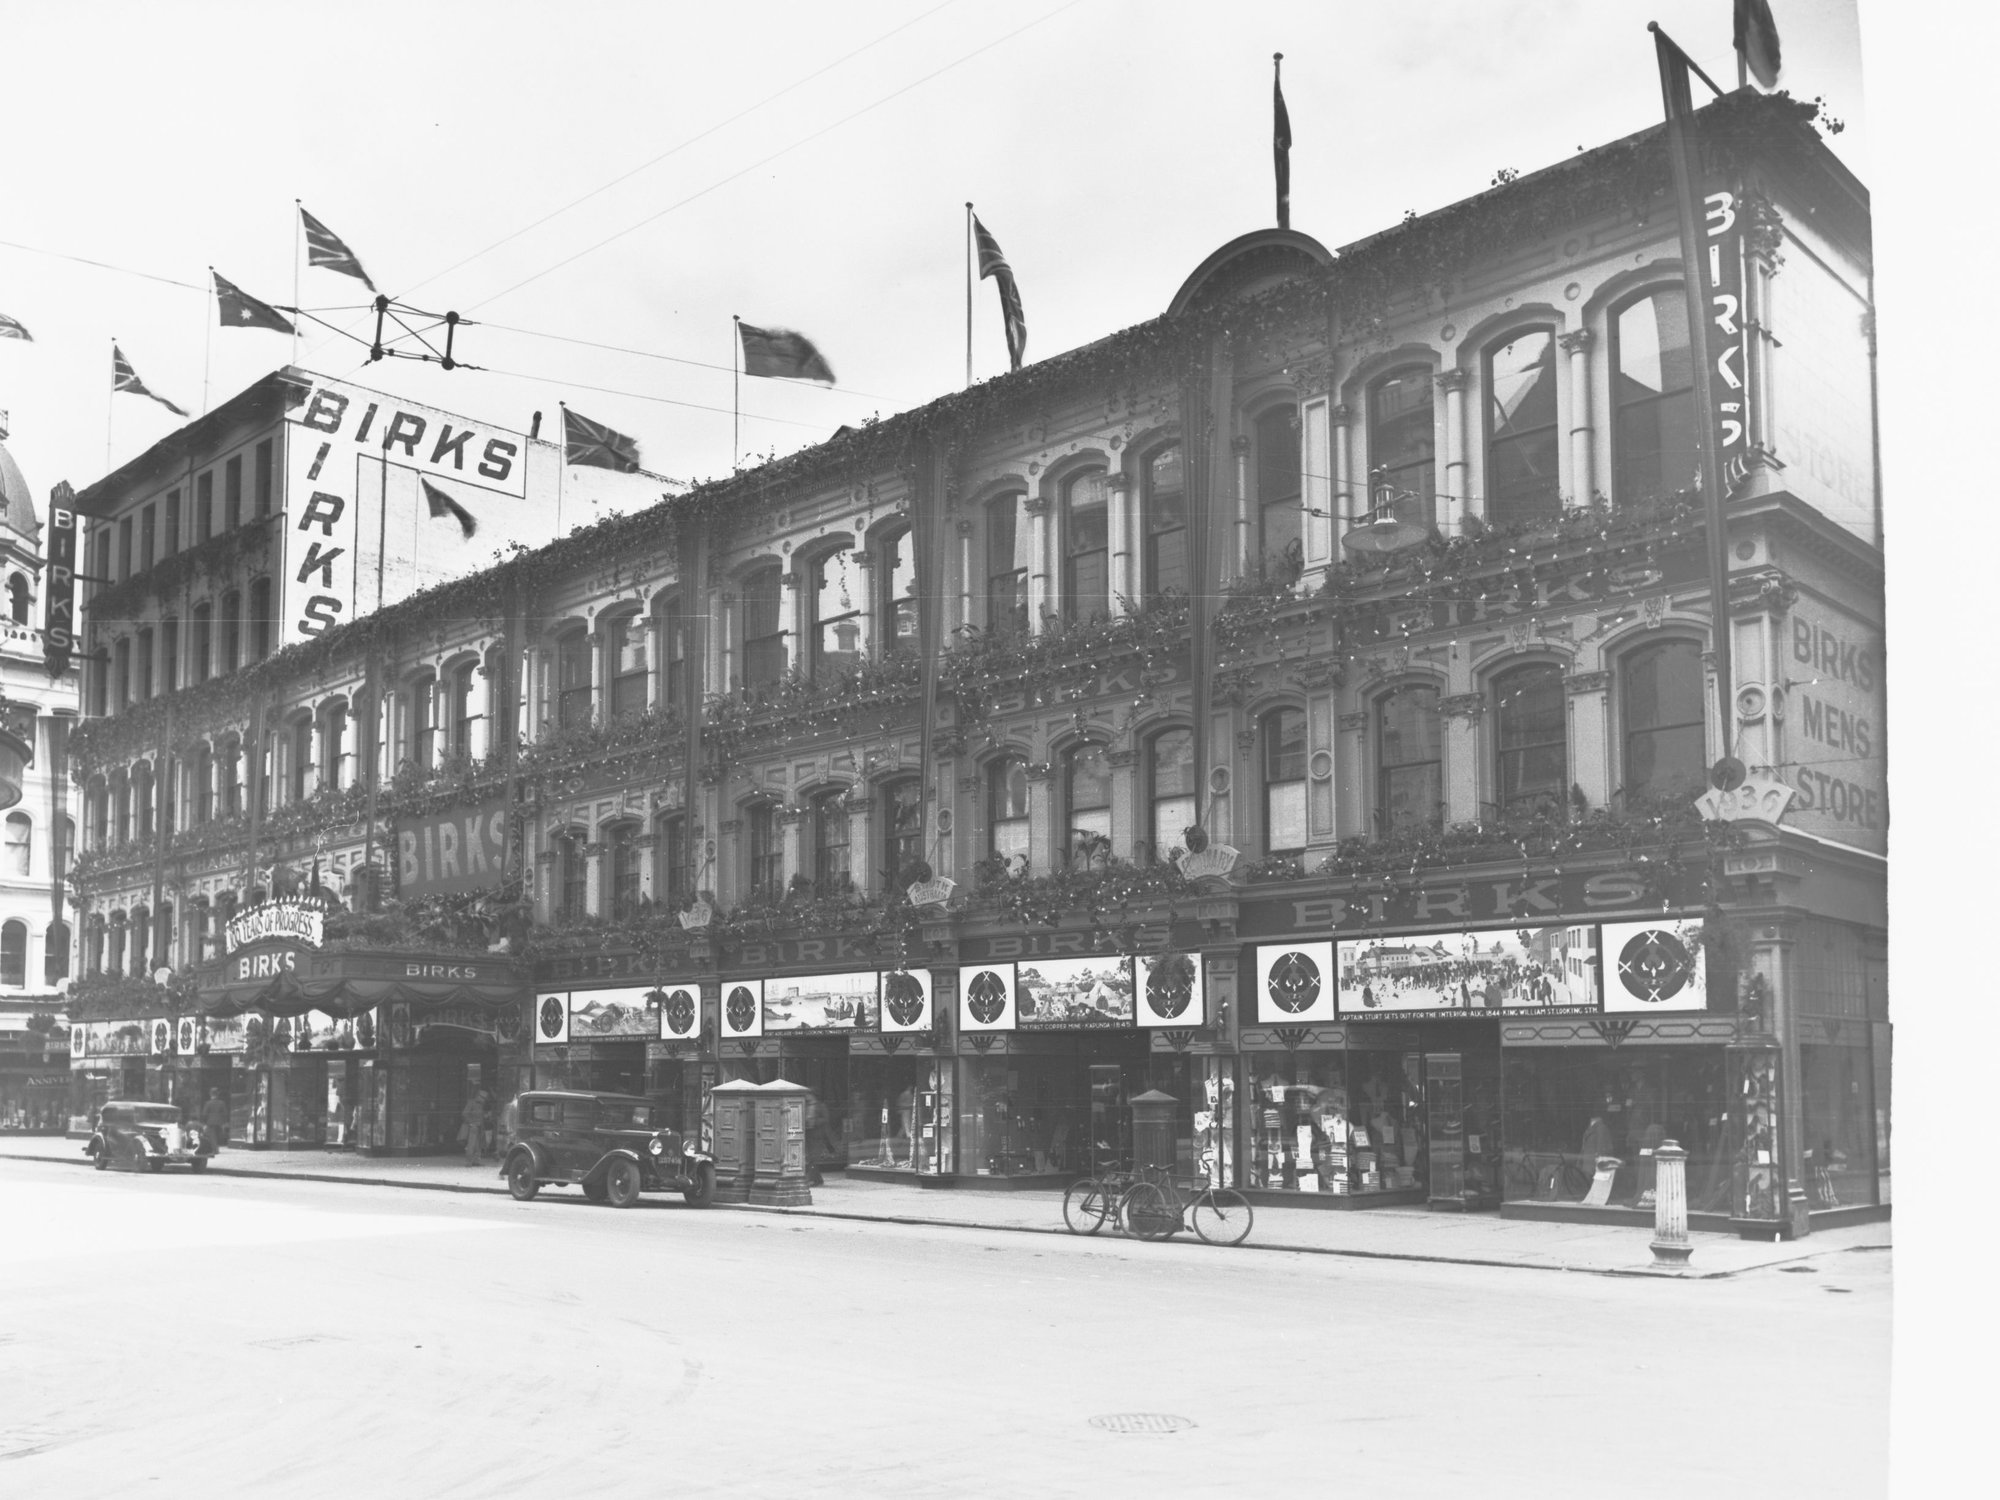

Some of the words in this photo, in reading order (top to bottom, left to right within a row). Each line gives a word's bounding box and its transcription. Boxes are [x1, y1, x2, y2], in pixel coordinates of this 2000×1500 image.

[303, 388, 518, 481] BIRKS
[50, 508, 73, 648] BIRKS
[1793, 615, 1875, 694] BIRKS
[1802, 694, 1871, 759] MENS
[1799, 767, 1878, 831] STORE
[399, 810, 511, 886] BIRKS
[241, 914, 263, 941] YEARS
[264, 911, 273, 933] OF
[1294, 871, 1646, 928] BIRKS
[240, 951, 295, 979] BIRKS
[987, 925, 1171, 955] BIRKS
[406, 963, 477, 979] BIRKS
[1339, 1013, 1363, 1021] CAPTAIN
[1556, 1007, 1581, 1015] LOOKING
